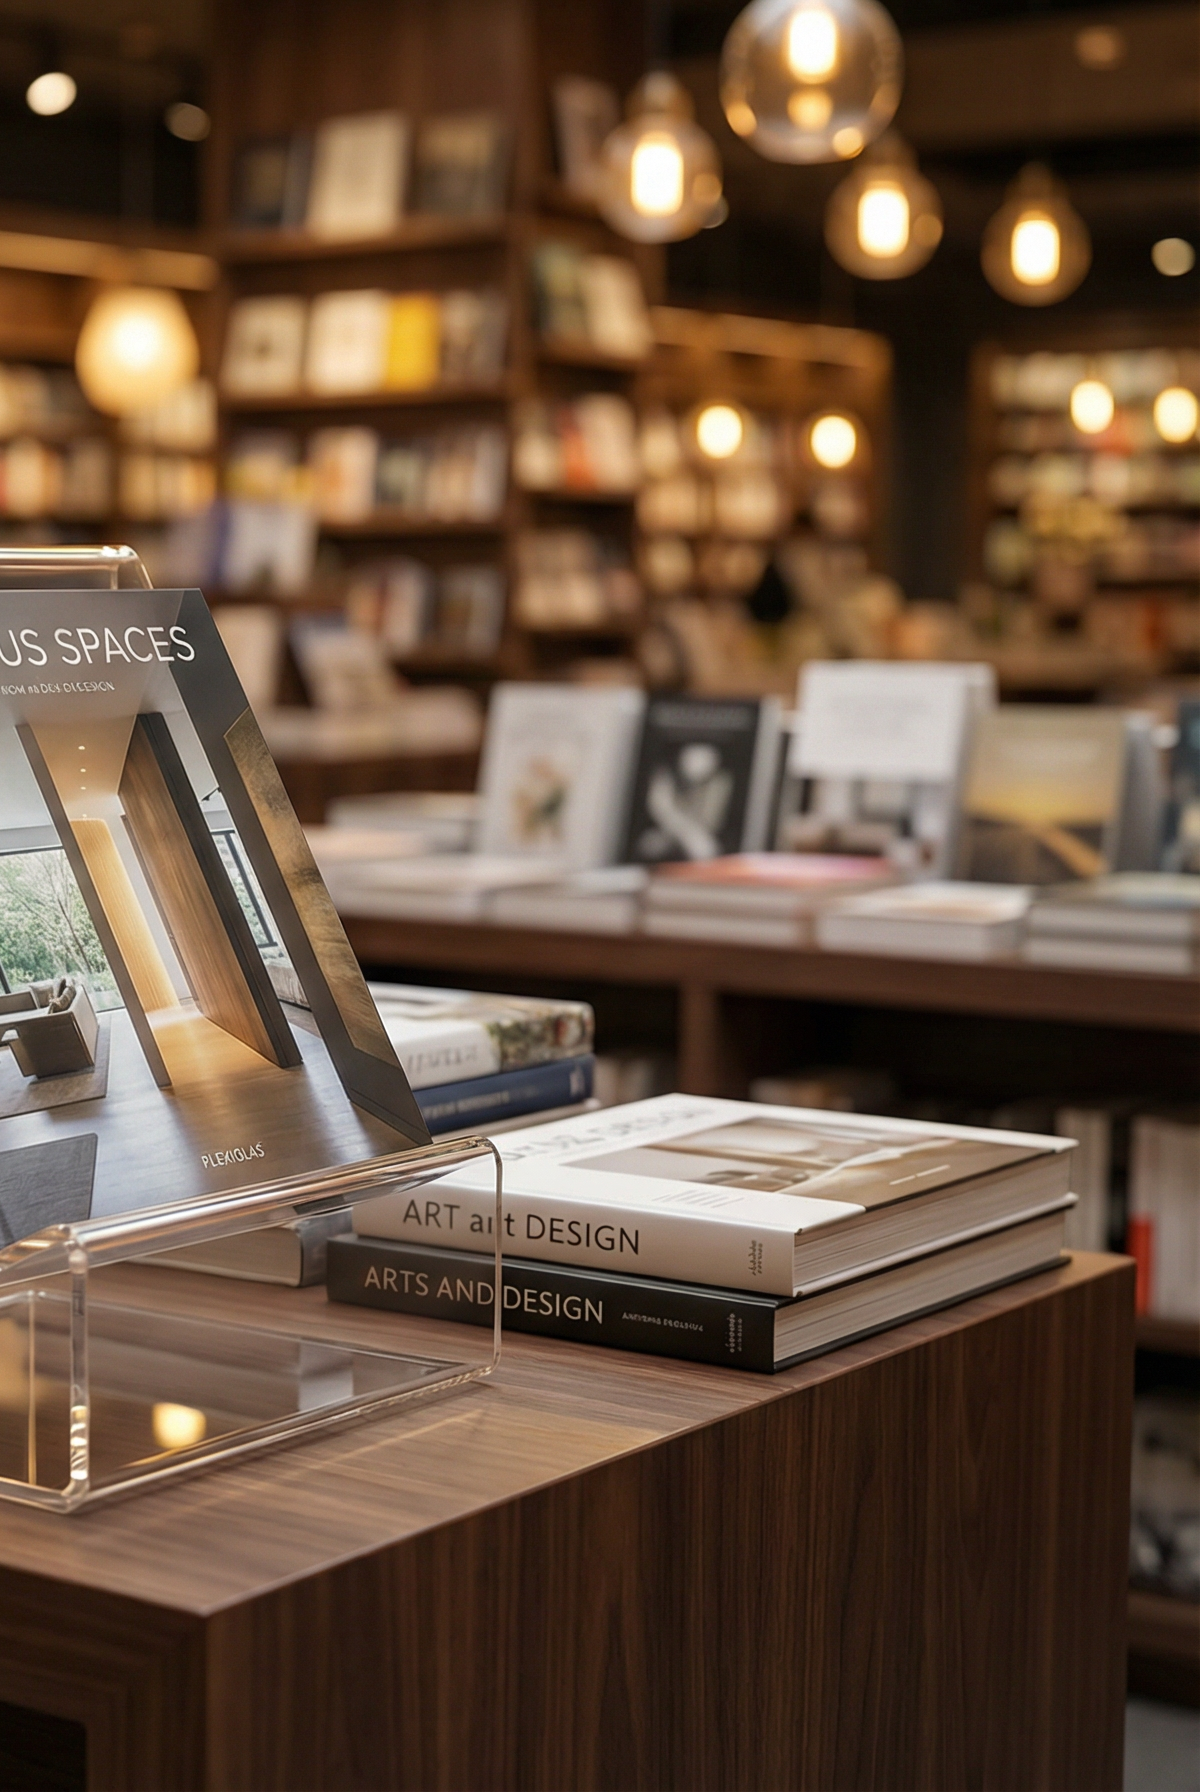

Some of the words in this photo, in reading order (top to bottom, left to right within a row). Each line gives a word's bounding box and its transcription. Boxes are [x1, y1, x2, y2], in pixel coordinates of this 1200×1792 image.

[54, 625, 196, 666] SPACES
[402, 1198, 461, 1231] ART
[526, 1213, 640, 1256] DESIGN
[364, 1265, 430, 1297] ARTS
[436, 1275, 494, 1306] AND
[502, 1285, 604, 1325] DESIGN
